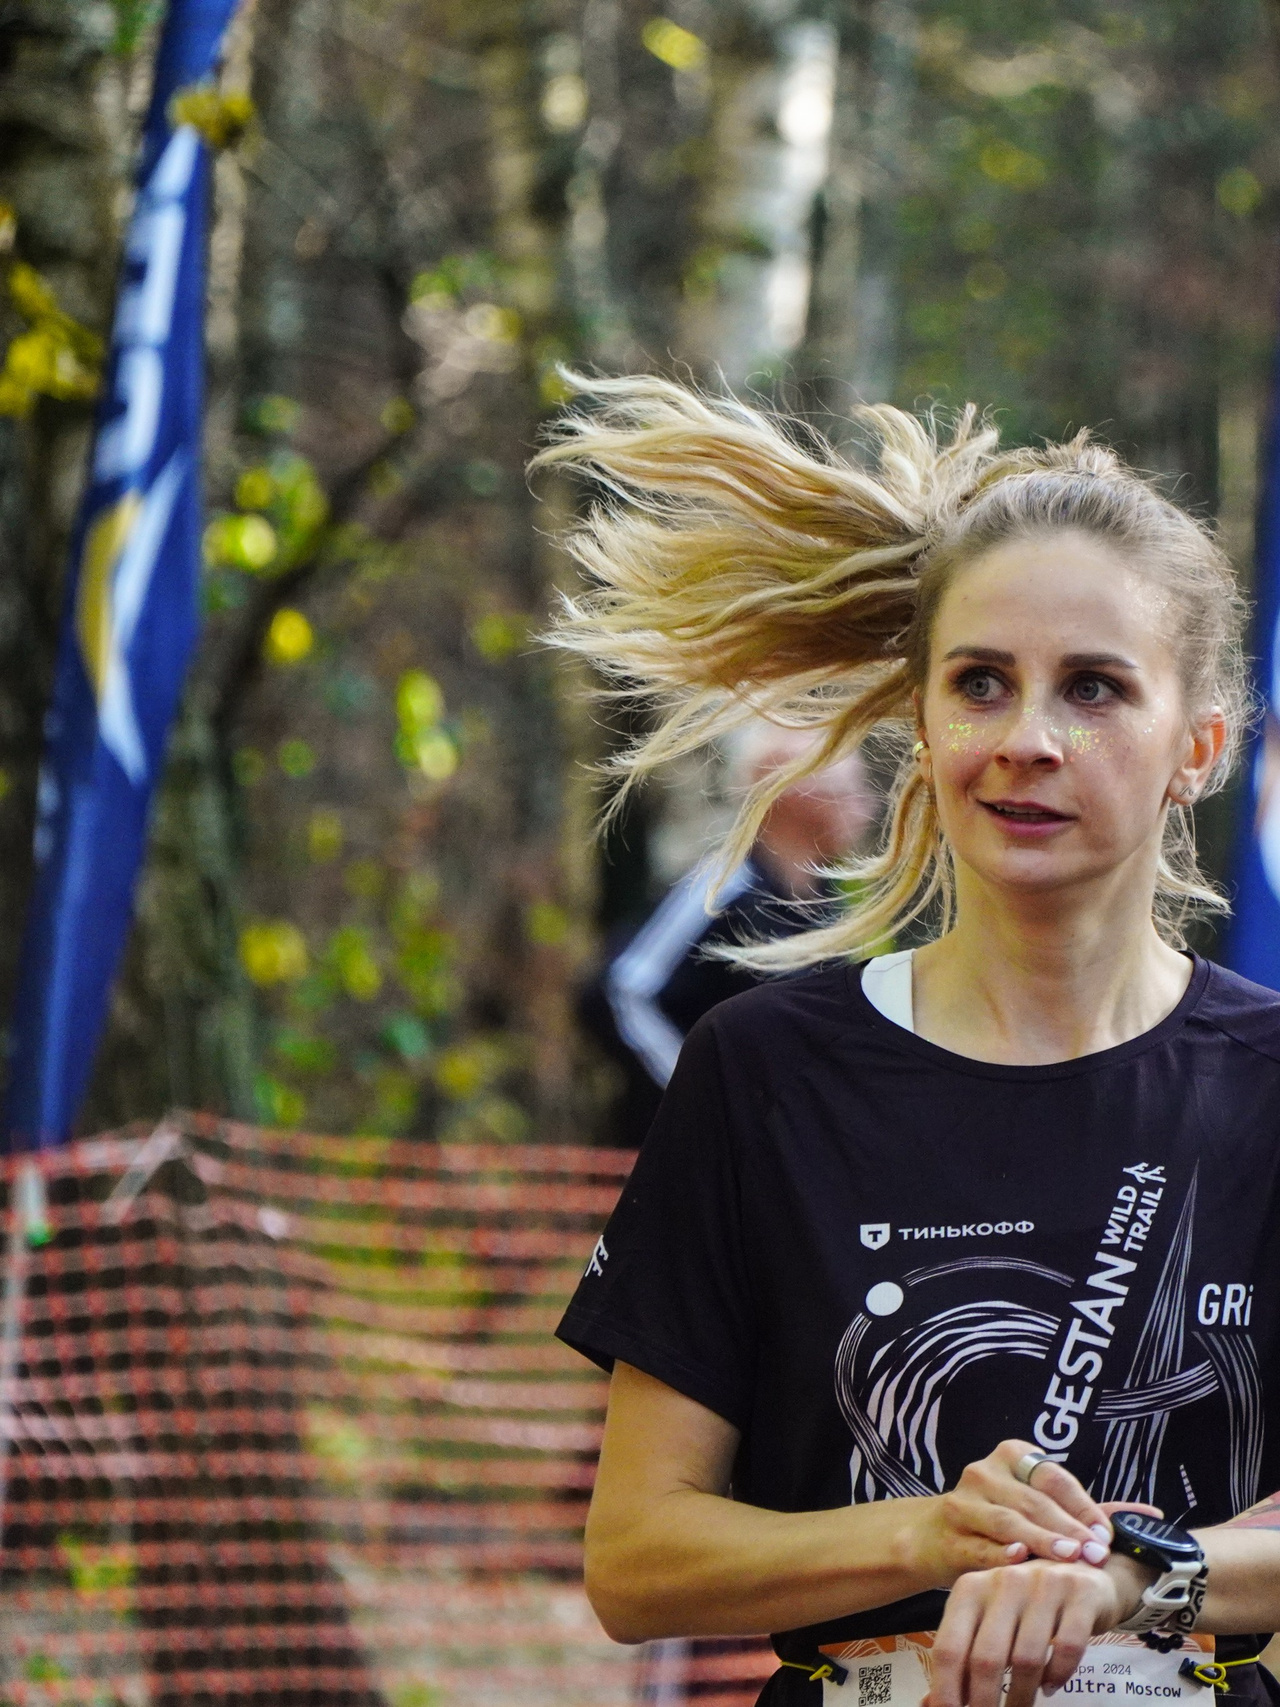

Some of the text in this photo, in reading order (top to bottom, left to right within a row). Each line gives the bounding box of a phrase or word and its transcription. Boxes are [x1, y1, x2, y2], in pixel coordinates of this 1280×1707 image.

[898, 1220, 1035, 1240] ТИНЬКОФФ
[1100, 1185, 1138, 1244] WILD
[1123, 1187, 1164, 1252] TRAIL
[1034, 1251, 1138, 1462] GESTAN
[1064, 1679, 1181, 1698] Ultra Moscow
[1103, 1663, 1132, 1676] 2024
